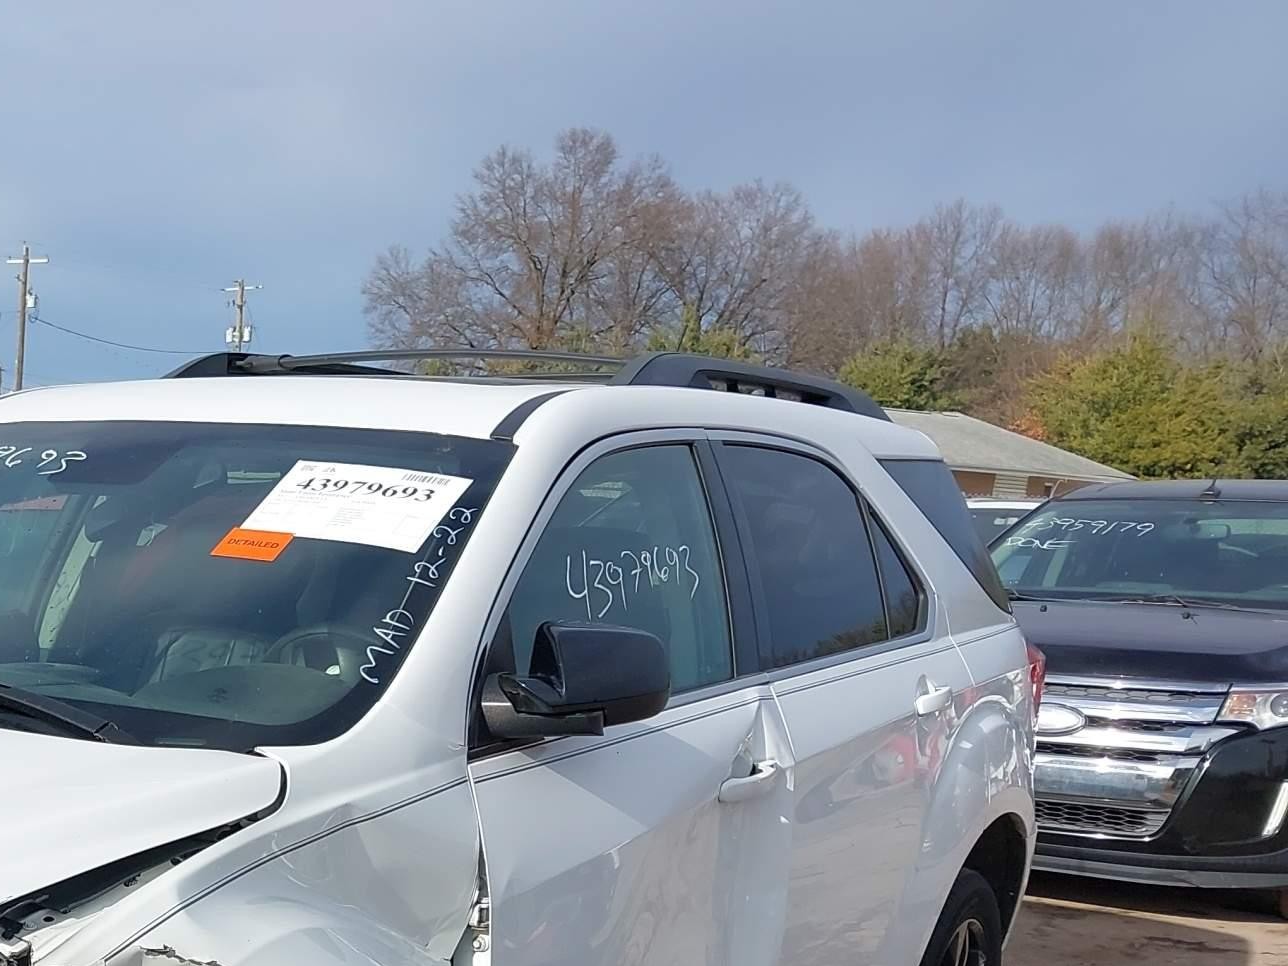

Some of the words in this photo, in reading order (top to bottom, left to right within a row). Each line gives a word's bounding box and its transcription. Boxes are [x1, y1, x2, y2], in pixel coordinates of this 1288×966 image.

[295, 476, 436, 502] 43979693
[227, 537, 280, 549] DETAILED
[406, 506, 480, 588] 12-22
[566, 545, 700, 621] 43979693
